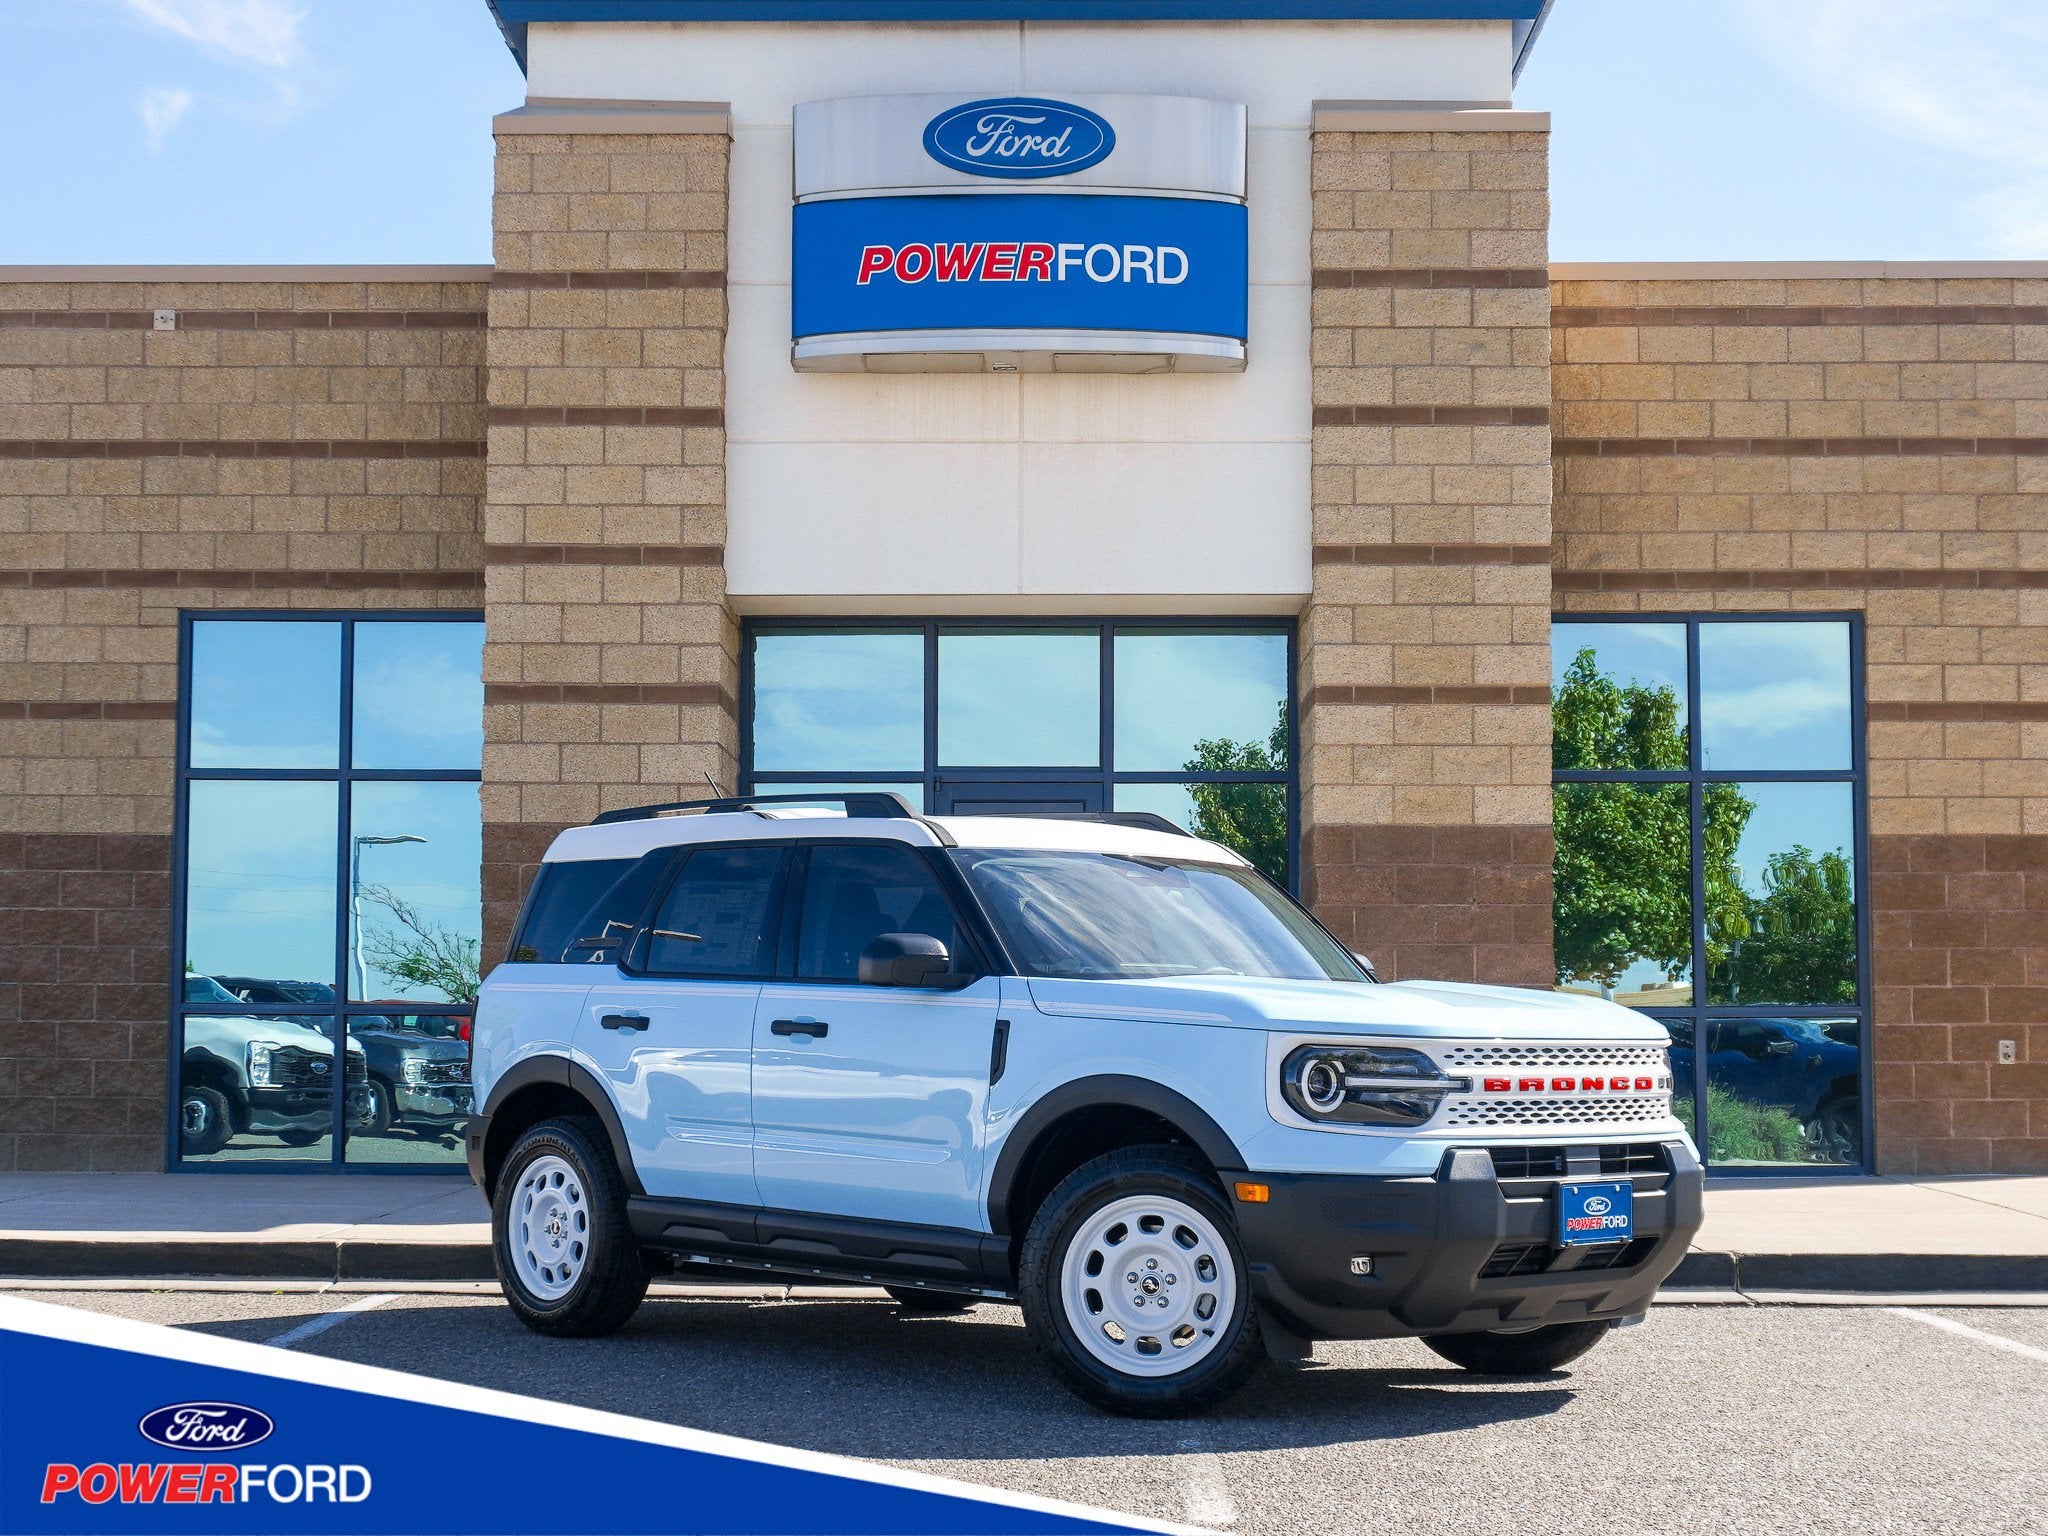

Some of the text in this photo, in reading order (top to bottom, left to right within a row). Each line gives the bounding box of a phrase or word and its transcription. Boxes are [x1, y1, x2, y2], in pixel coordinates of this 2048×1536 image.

[966, 114, 1072, 157] Ford
[1484, 1076, 1653, 1093] BRONCO
[1588, 1200, 1606, 1212] Ford
